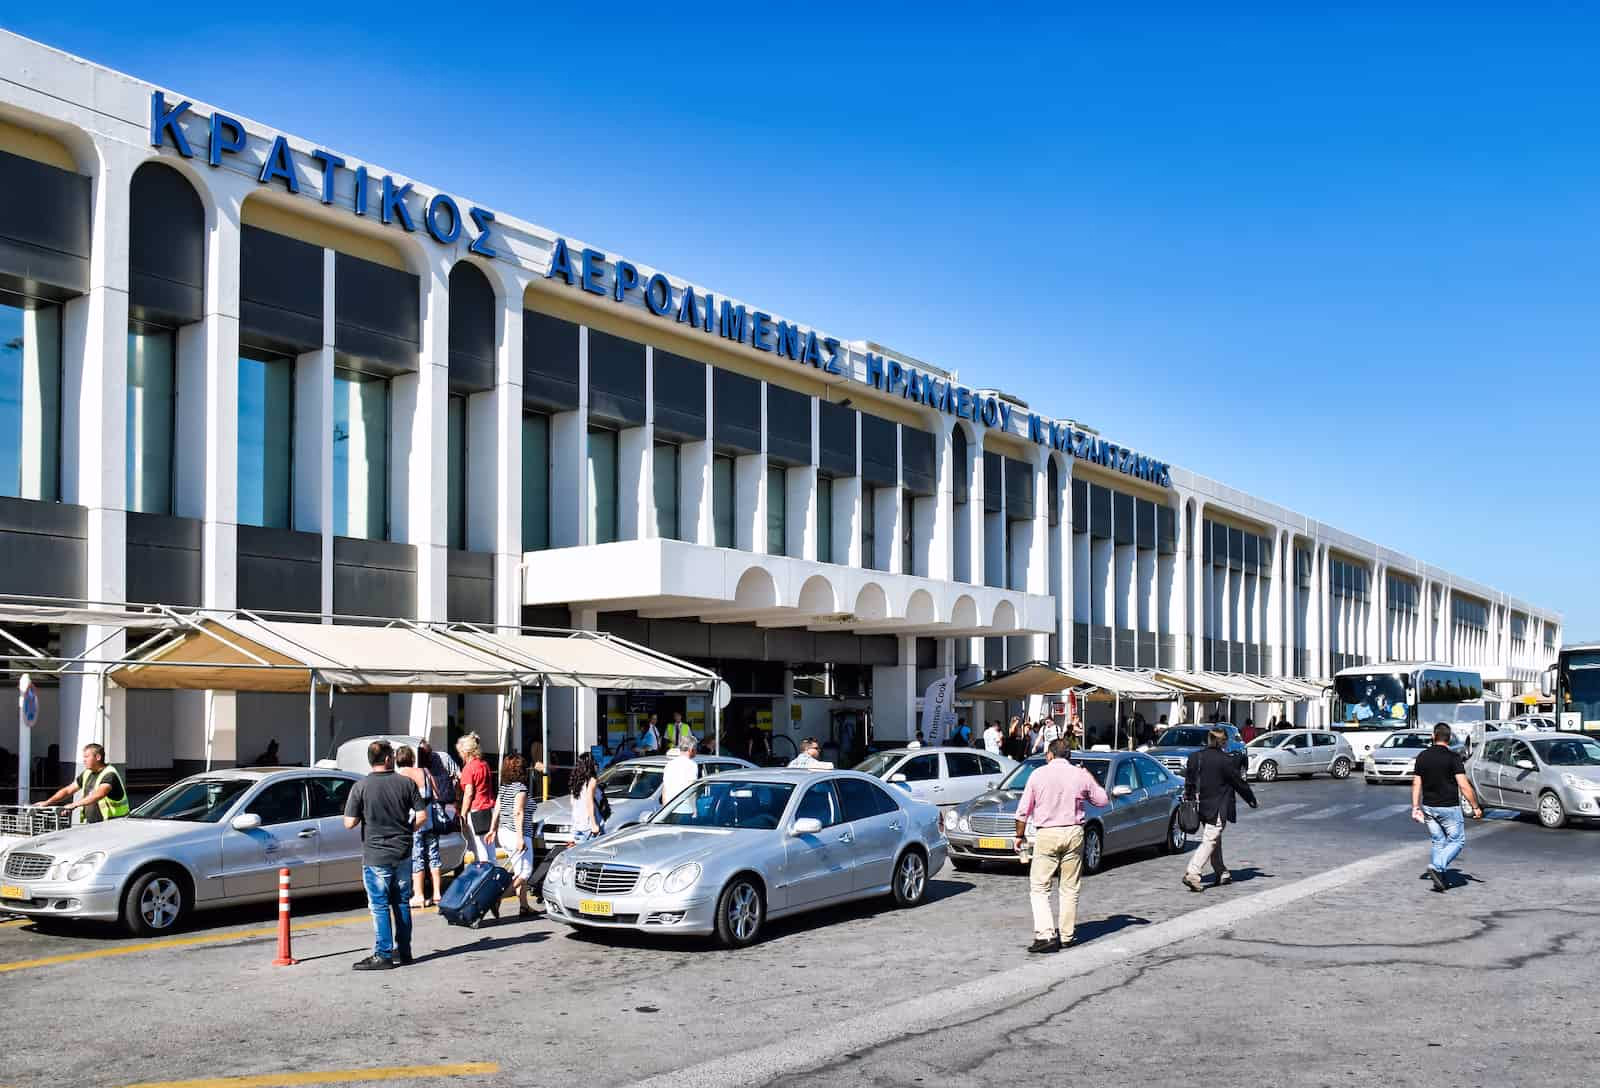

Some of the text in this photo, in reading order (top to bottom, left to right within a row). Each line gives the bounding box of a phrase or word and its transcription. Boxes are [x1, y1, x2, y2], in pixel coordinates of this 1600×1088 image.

[151, 90, 497, 257] ΚΡΑΤΙΚΟΣ
[546, 238, 842, 374] ΑΕΡΟΛΙΜΕΝΑΣ
[865, 352, 1012, 432] ΗΡΑΚΛΕΙΟΥ
[928, 681, 946, 739] Thomas Cook
